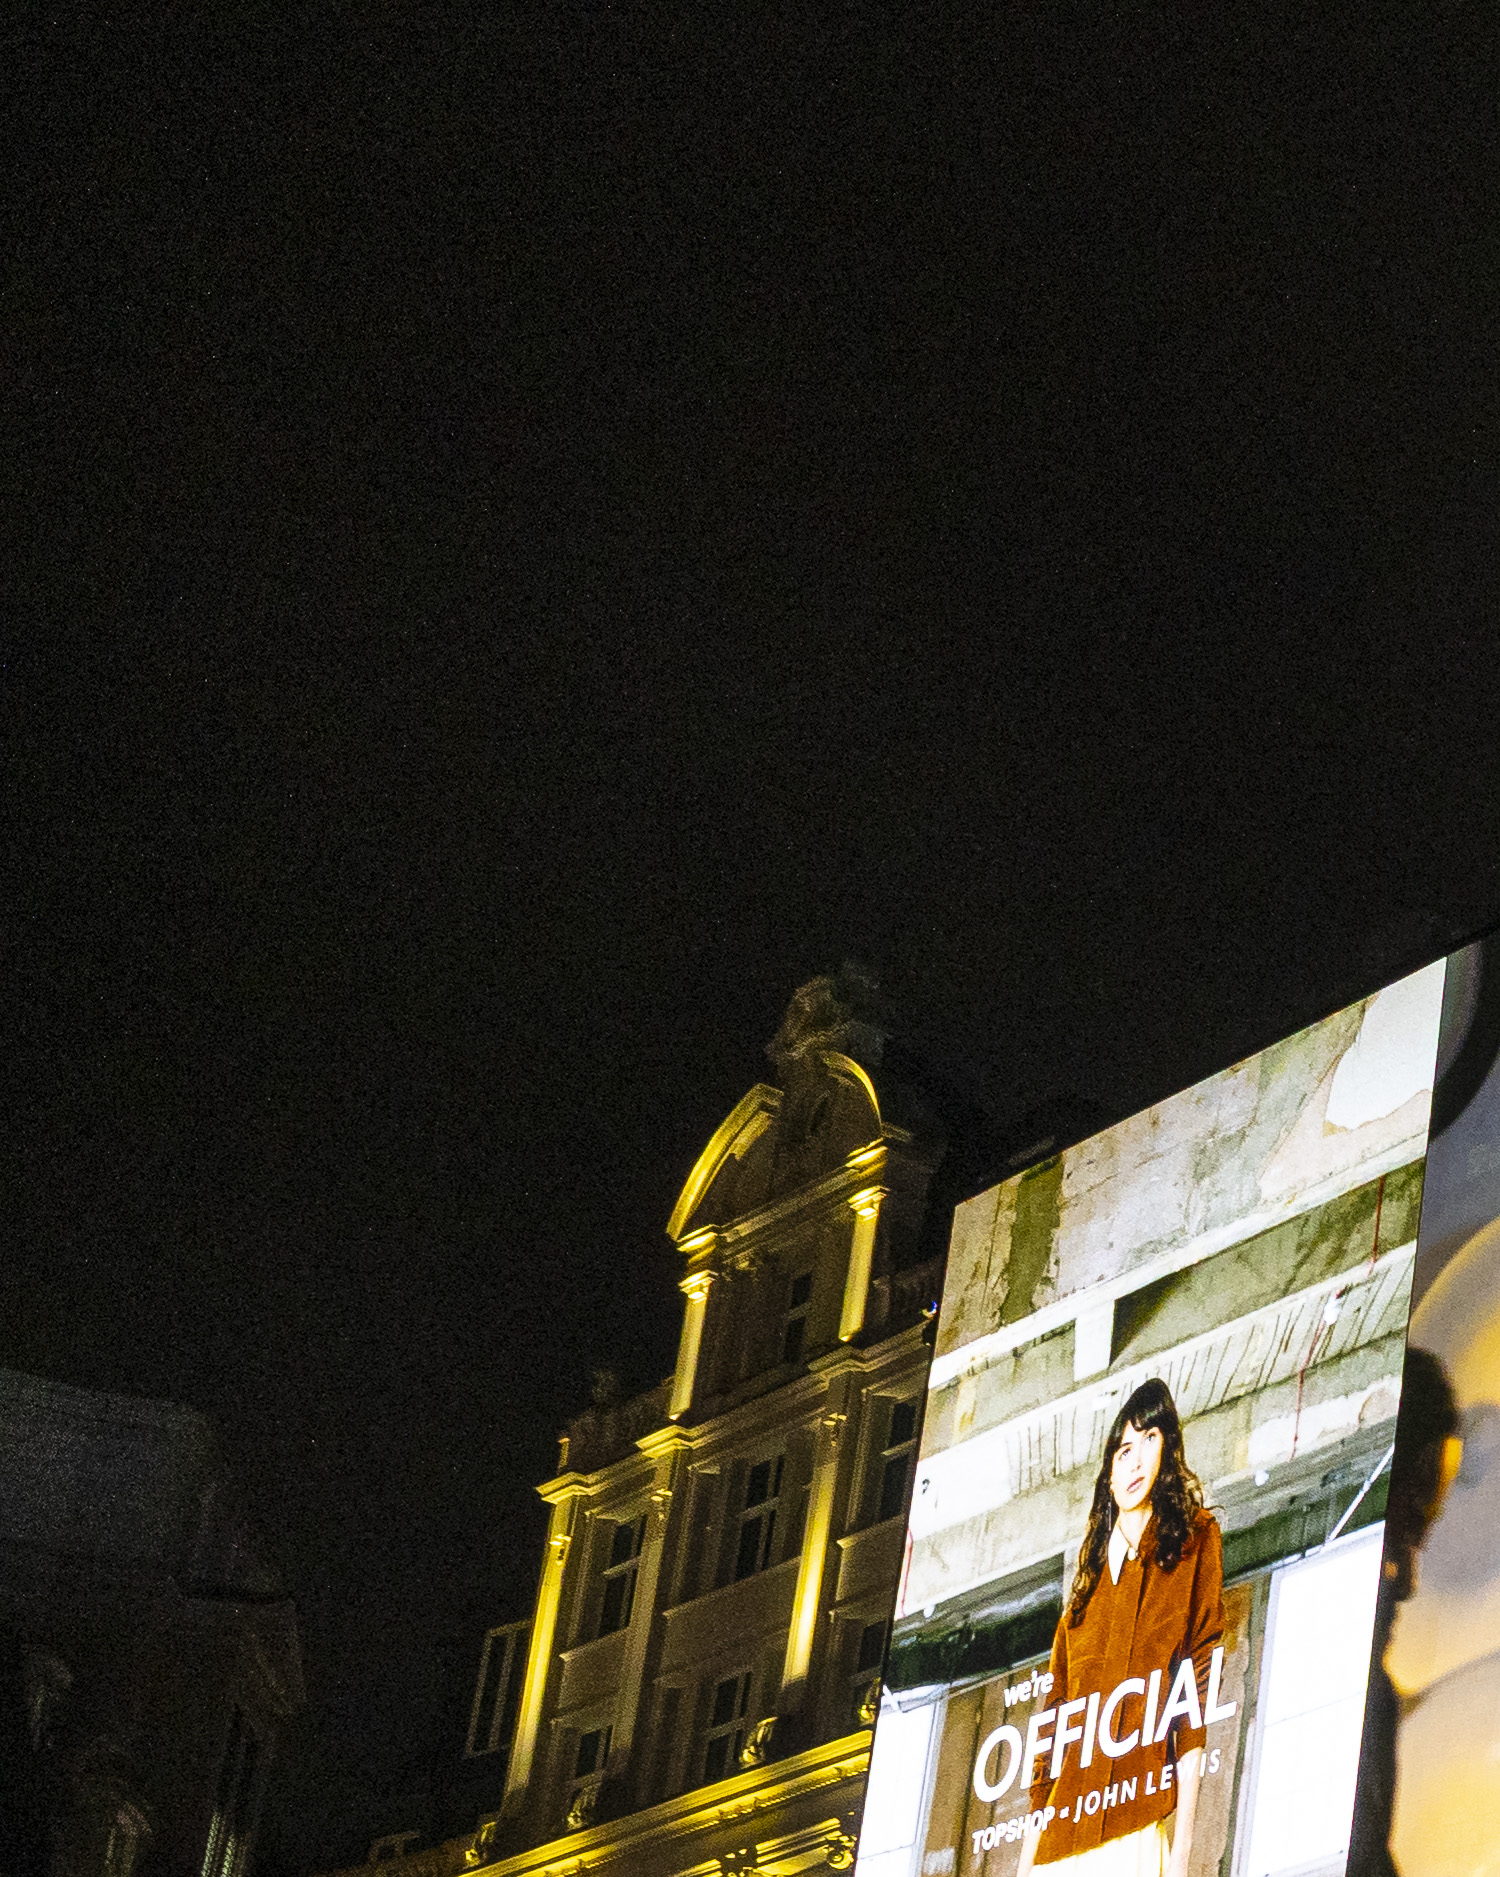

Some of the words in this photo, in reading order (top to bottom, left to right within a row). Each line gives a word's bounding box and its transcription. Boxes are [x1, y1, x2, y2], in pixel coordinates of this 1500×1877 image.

[973, 1646, 1238, 1803] OFFICIAL
[1003, 1669, 1054, 1708] we're
[971, 1805, 1055, 1854] TOPSHOP
[1073, 1776, 1138, 1824] JOHN
[1144, 1748, 1221, 1796] LEWIS
